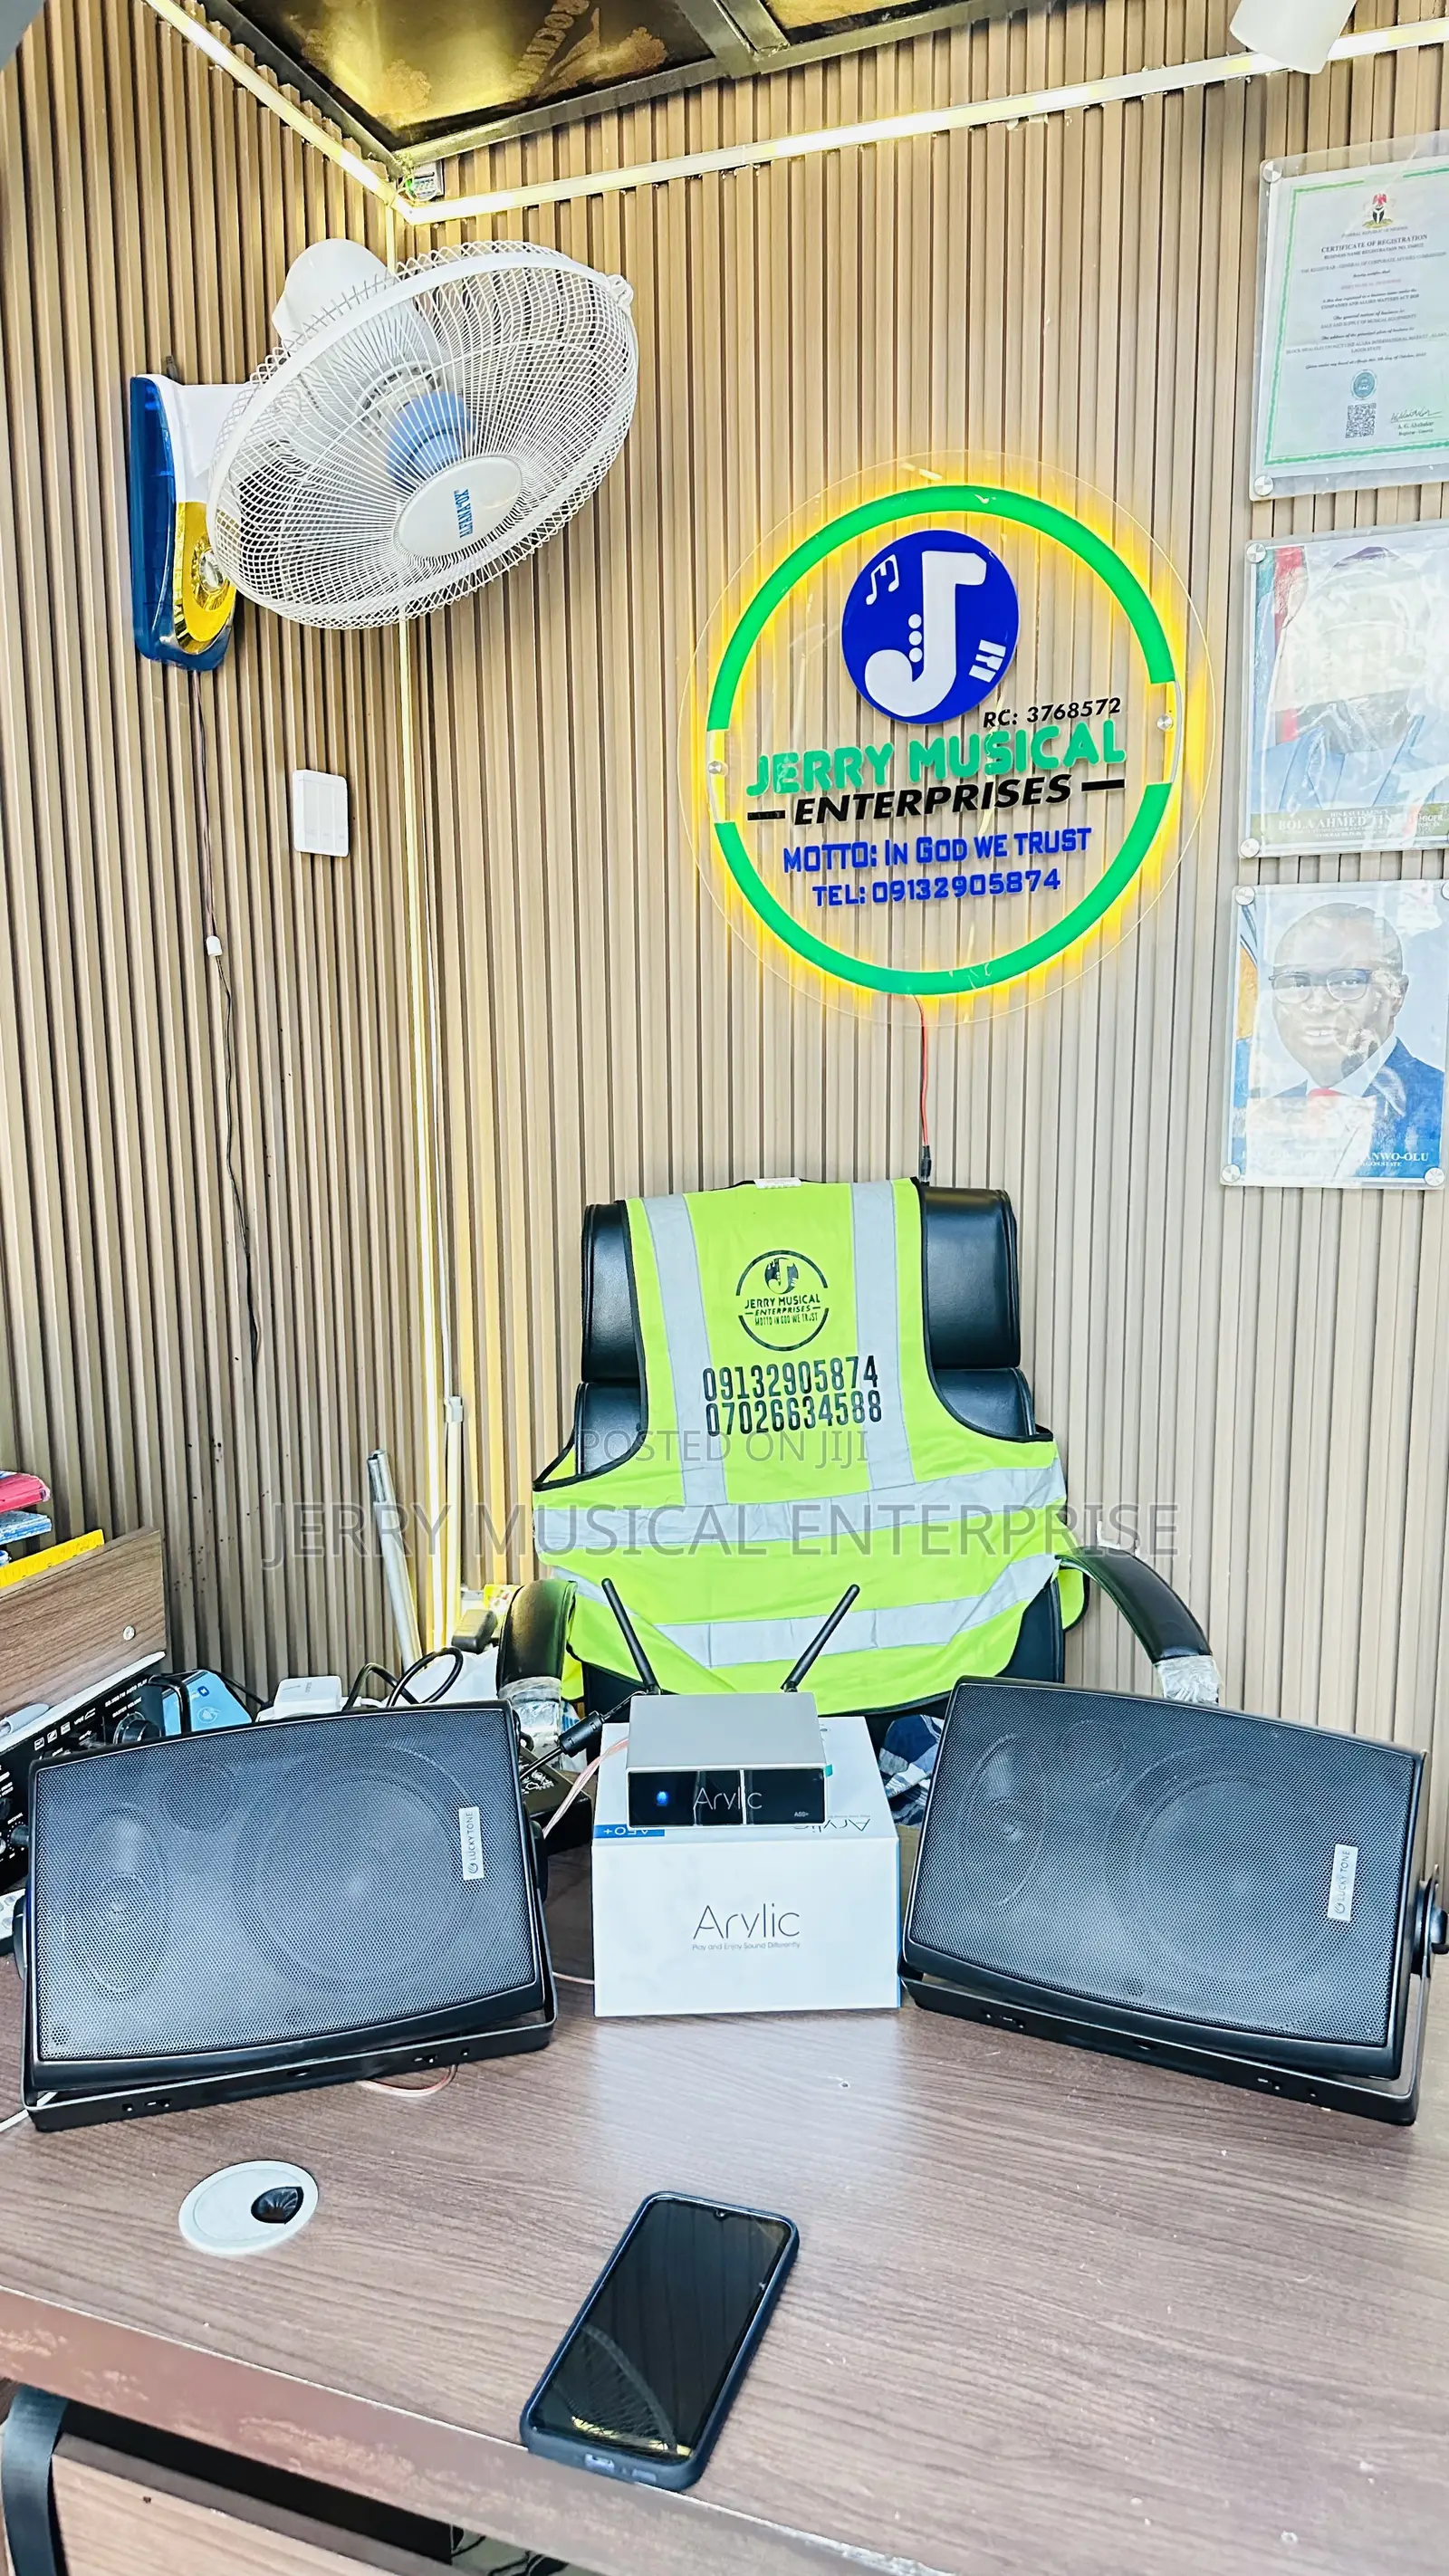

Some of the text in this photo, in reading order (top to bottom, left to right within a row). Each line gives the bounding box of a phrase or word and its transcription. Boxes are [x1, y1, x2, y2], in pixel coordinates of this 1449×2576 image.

[1321, 242, 1365, 253] CERTIFICATE
[1377, 234, 1428, 246] REGISTRATION
[984, 697, 1122, 728] RC: 3768572
[746, 718, 1127, 797] JERRY MUSICAL
[793, 773, 1074, 826] ENTERPRISES
[1316, 816, 1367, 828] AHMED
[783, 828, 1092, 873] MOTTO: IN GOD WE TRUST
[812, 868, 1061, 906] TEL: 09132905874
[1366, 1152, 1430, 1162] ANWO-OLU
[744, 1294, 820, 1309] JERRY MUSICAL
[755, 1305, 811, 1316] ENTERPRISES
[792, 1314, 801, 1323] WE
[702, 1355, 878, 1402] 09132905874
[705, 1389, 882, 1437] 07026634588
[693, 1787, 762, 1810] Arylc
[466, 1812, 476, 1861] LUCKY TONE
[1337, 1850, 1350, 1901] LUCKY TONE
[693, 1902, 800, 1939] Arylic
[724, 1943, 742, 1951] Enjoy
